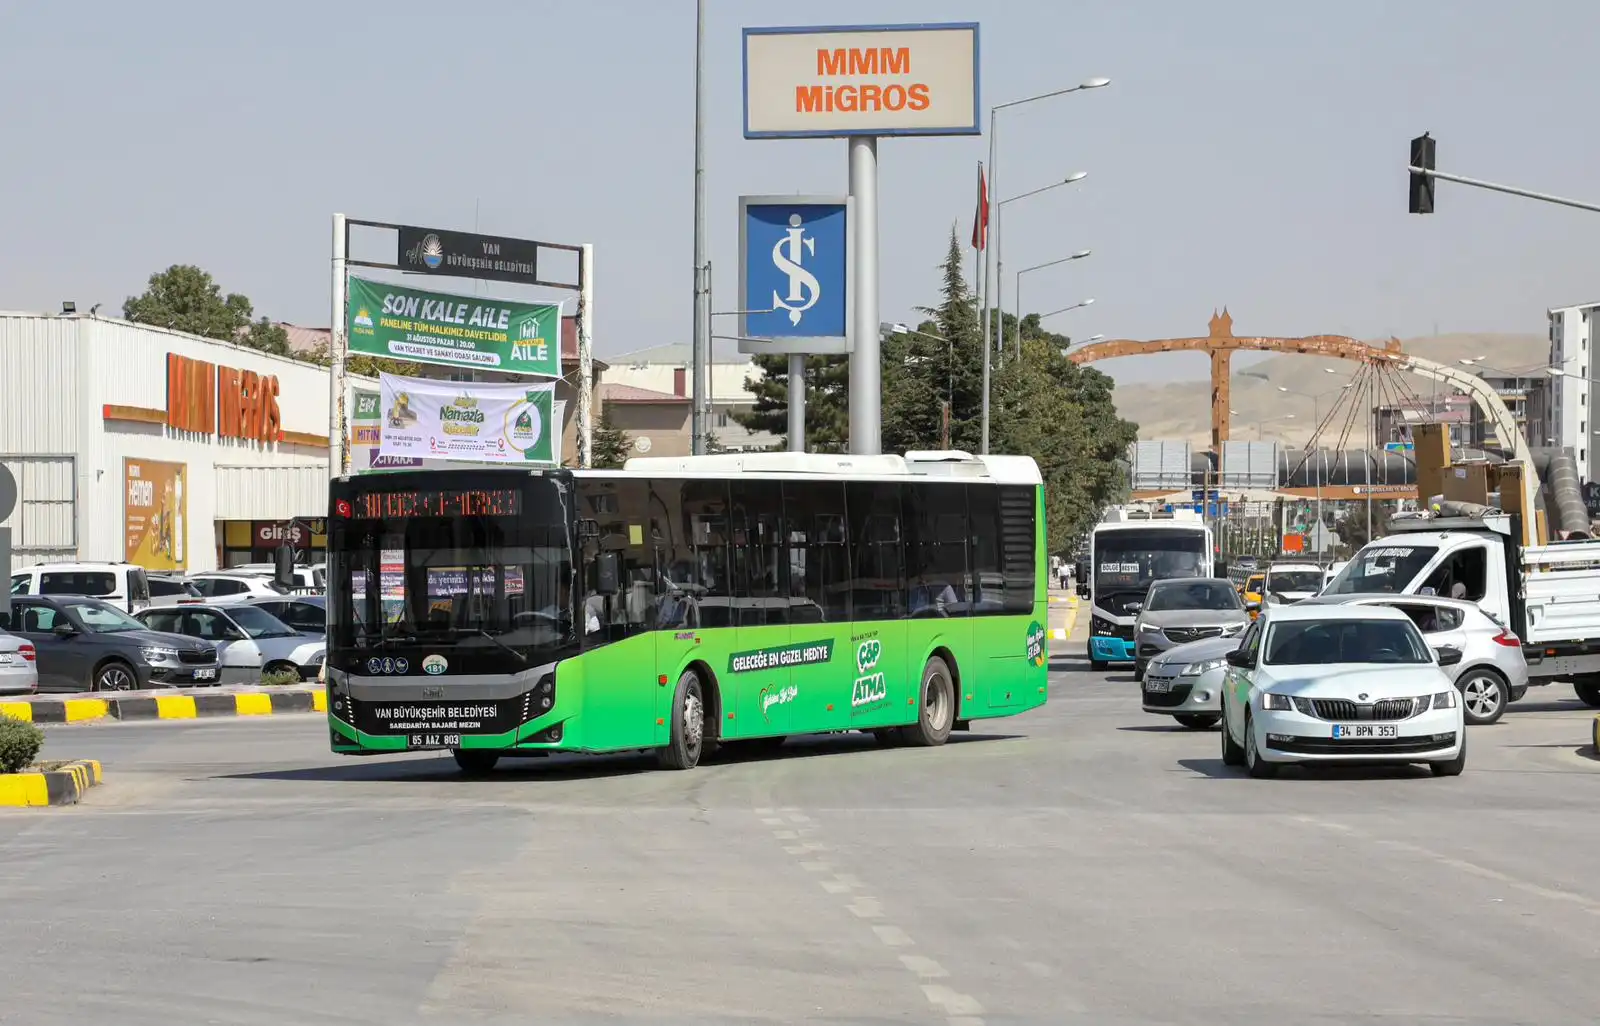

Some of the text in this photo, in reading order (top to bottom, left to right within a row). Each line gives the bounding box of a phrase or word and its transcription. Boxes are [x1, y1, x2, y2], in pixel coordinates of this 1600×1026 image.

[817, 48, 910, 76] MMM
[482, 242, 500, 256] VAN
[446, 254, 534, 274] BÜYÜKŞEHİR BELEDİYESİ
[381, 293, 420, 318] SON
[420, 299, 467, 324] KALE
[414, 322, 429, 334] TÜM
[429, 324, 464, 339] HALKIMIZ
[436, 337, 455, 347] PAZAR
[440, 406, 484, 423] Namazla
[733, 651, 768, 671] GELECEĞE
[769, 653, 779, 665] EN
[853, 673, 886, 704] ATMA
[375, 704, 497, 720] VAN BÜYÜKŞEHİR BELEDİYESİ
[425, 734, 440, 744] AAZ
[444, 734, 459, 744] 803
[1340, 726, 1395, 737] 34 BPN 353
